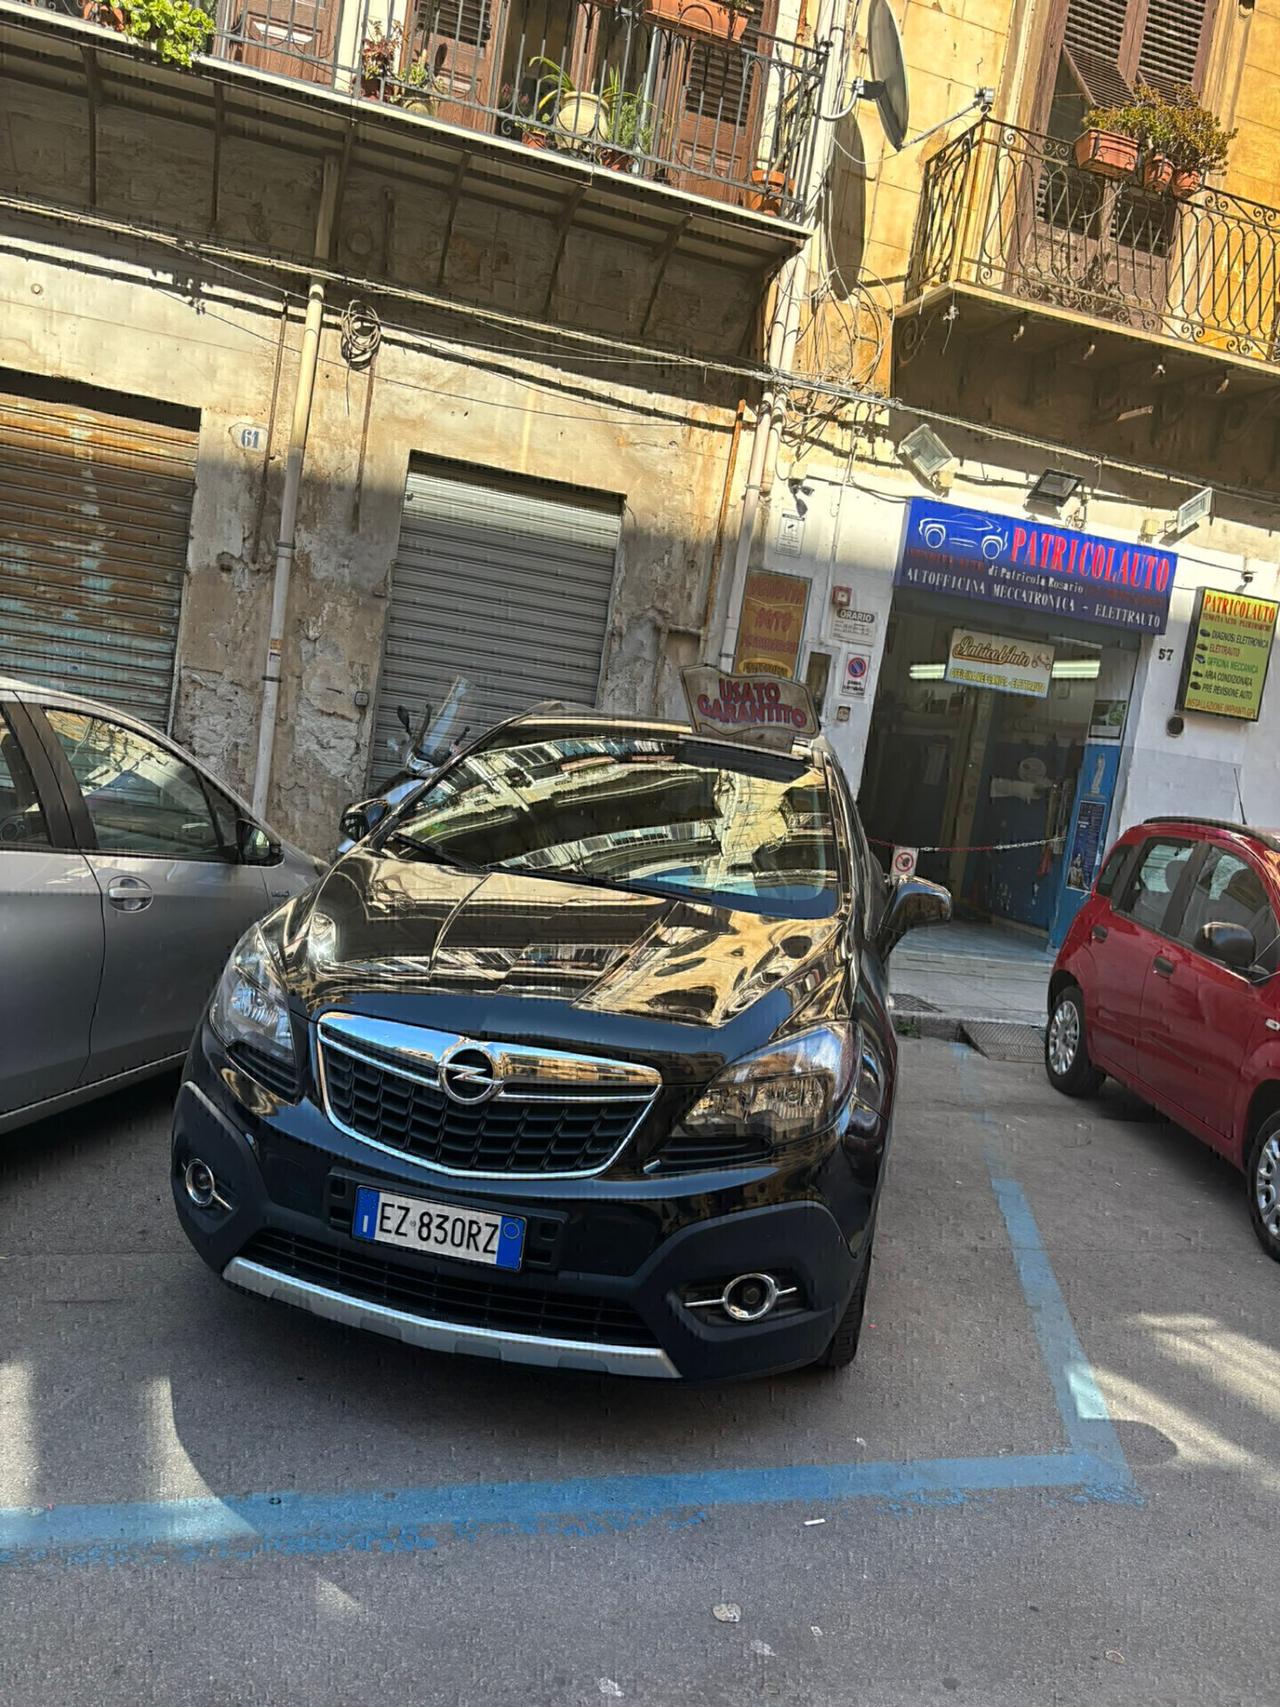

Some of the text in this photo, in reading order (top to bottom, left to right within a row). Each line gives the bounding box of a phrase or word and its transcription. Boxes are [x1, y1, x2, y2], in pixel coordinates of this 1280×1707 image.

[241, 429, 260, 449] 61
[1010, 527, 1169, 592] PATRICOLAUTO
[988, 565, 1084, 594] di Patricola Rosario
[907, 568, 986, 594] AUTOFFICINA
[993, 583, 1075, 612] MECCATRONICA
[1095, 603, 1161, 628] ELETTRAUTO
[1203, 594, 1275, 624] PATRICOLAUTO
[840, 610, 872, 622] ORARIO
[1158, 647, 1174, 661] 57
[719, 678, 781, 704] USATO
[697, 693, 807, 728] GARANTITO
